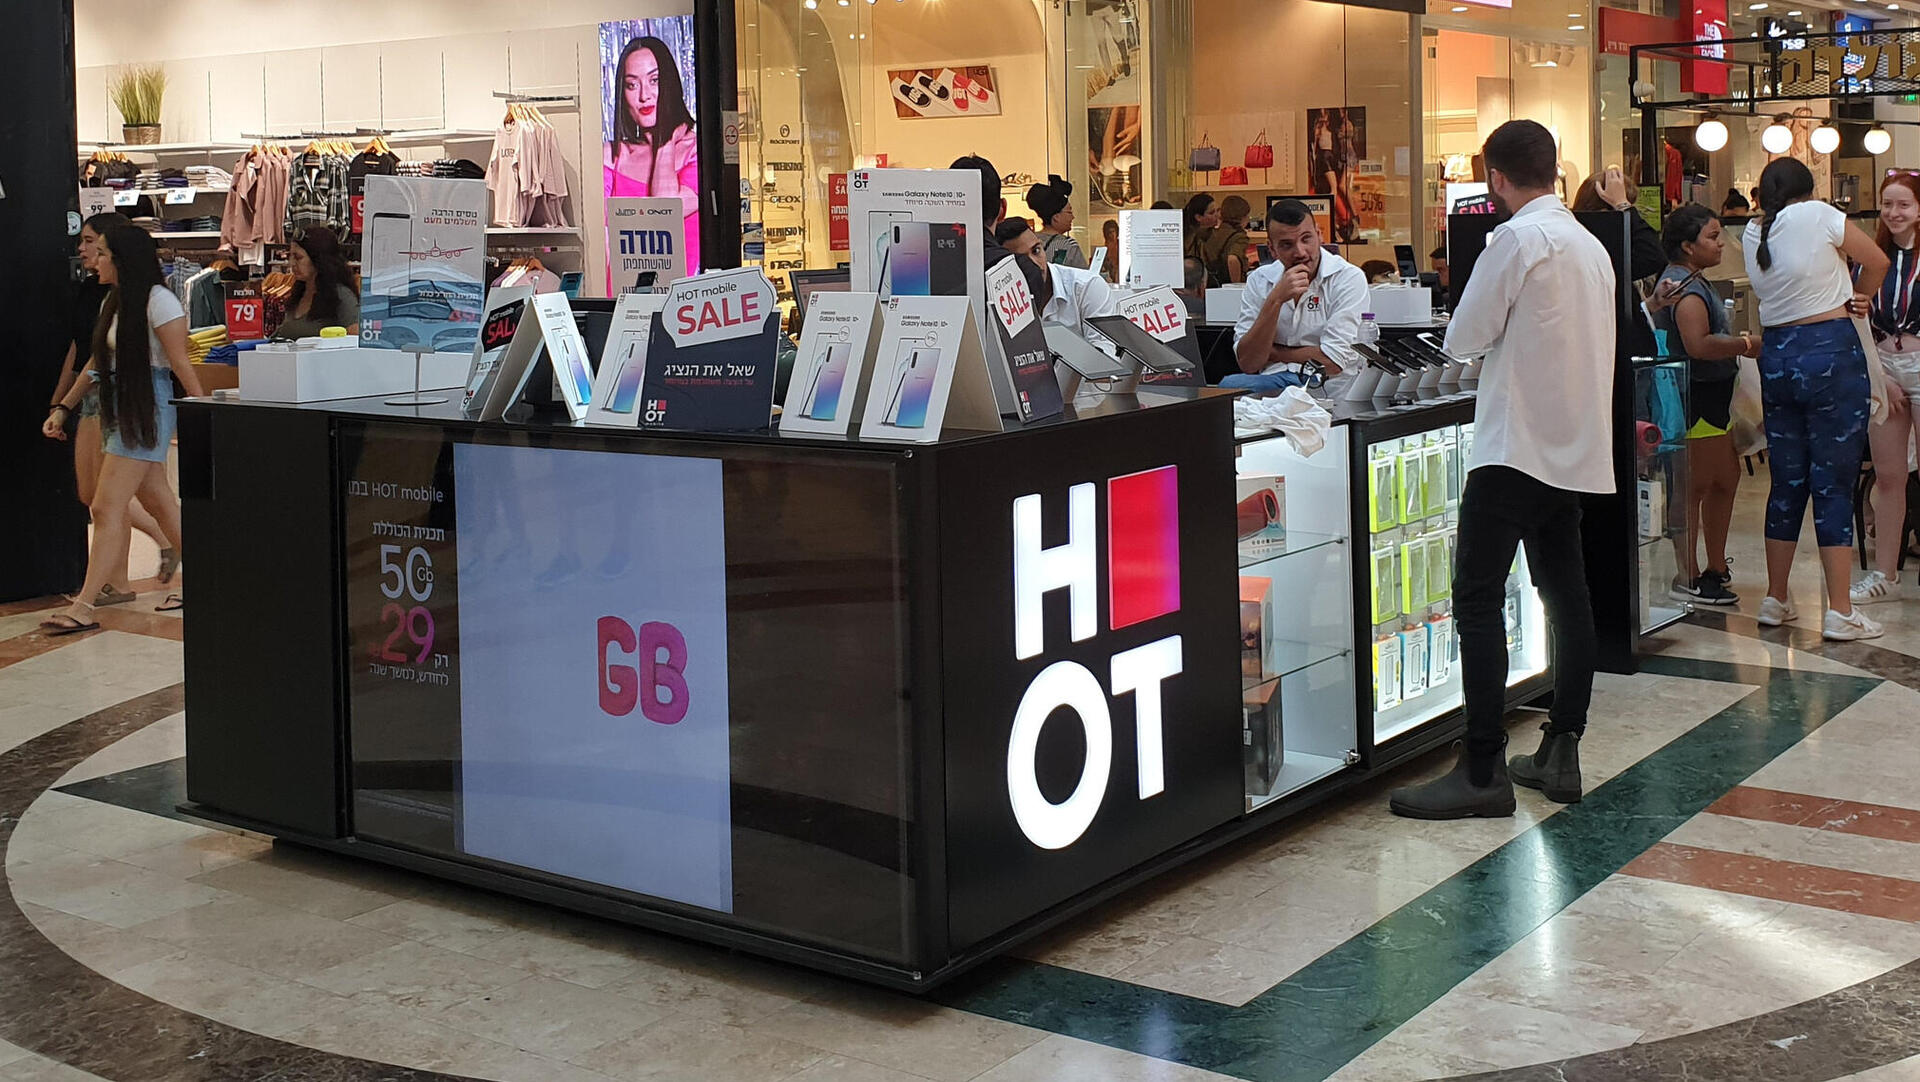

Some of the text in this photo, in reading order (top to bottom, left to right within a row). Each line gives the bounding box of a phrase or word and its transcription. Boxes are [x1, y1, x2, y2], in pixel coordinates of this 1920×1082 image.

[905, 191, 930, 200] Galaxy
[619, 230, 673, 255] תודה
[677, 289, 699, 303] HOT
[701, 282, 737, 298] mobile
[999, 280, 1030, 325] SALE
[677, 292, 761, 335] SALE
[1124, 297, 1160, 316] HOT mobile
[901, 320, 920, 328] Galaxy
[664, 363, 756, 377] שאל את הנציג
[372, 481, 398, 499] HOT
[400, 485, 444, 503] mobile
[372, 521, 445, 542] תכנית הכוללת
[369, 662, 387, 676] שנה
[434, 653, 449, 668] רק
[598, 616, 690, 725] GB
